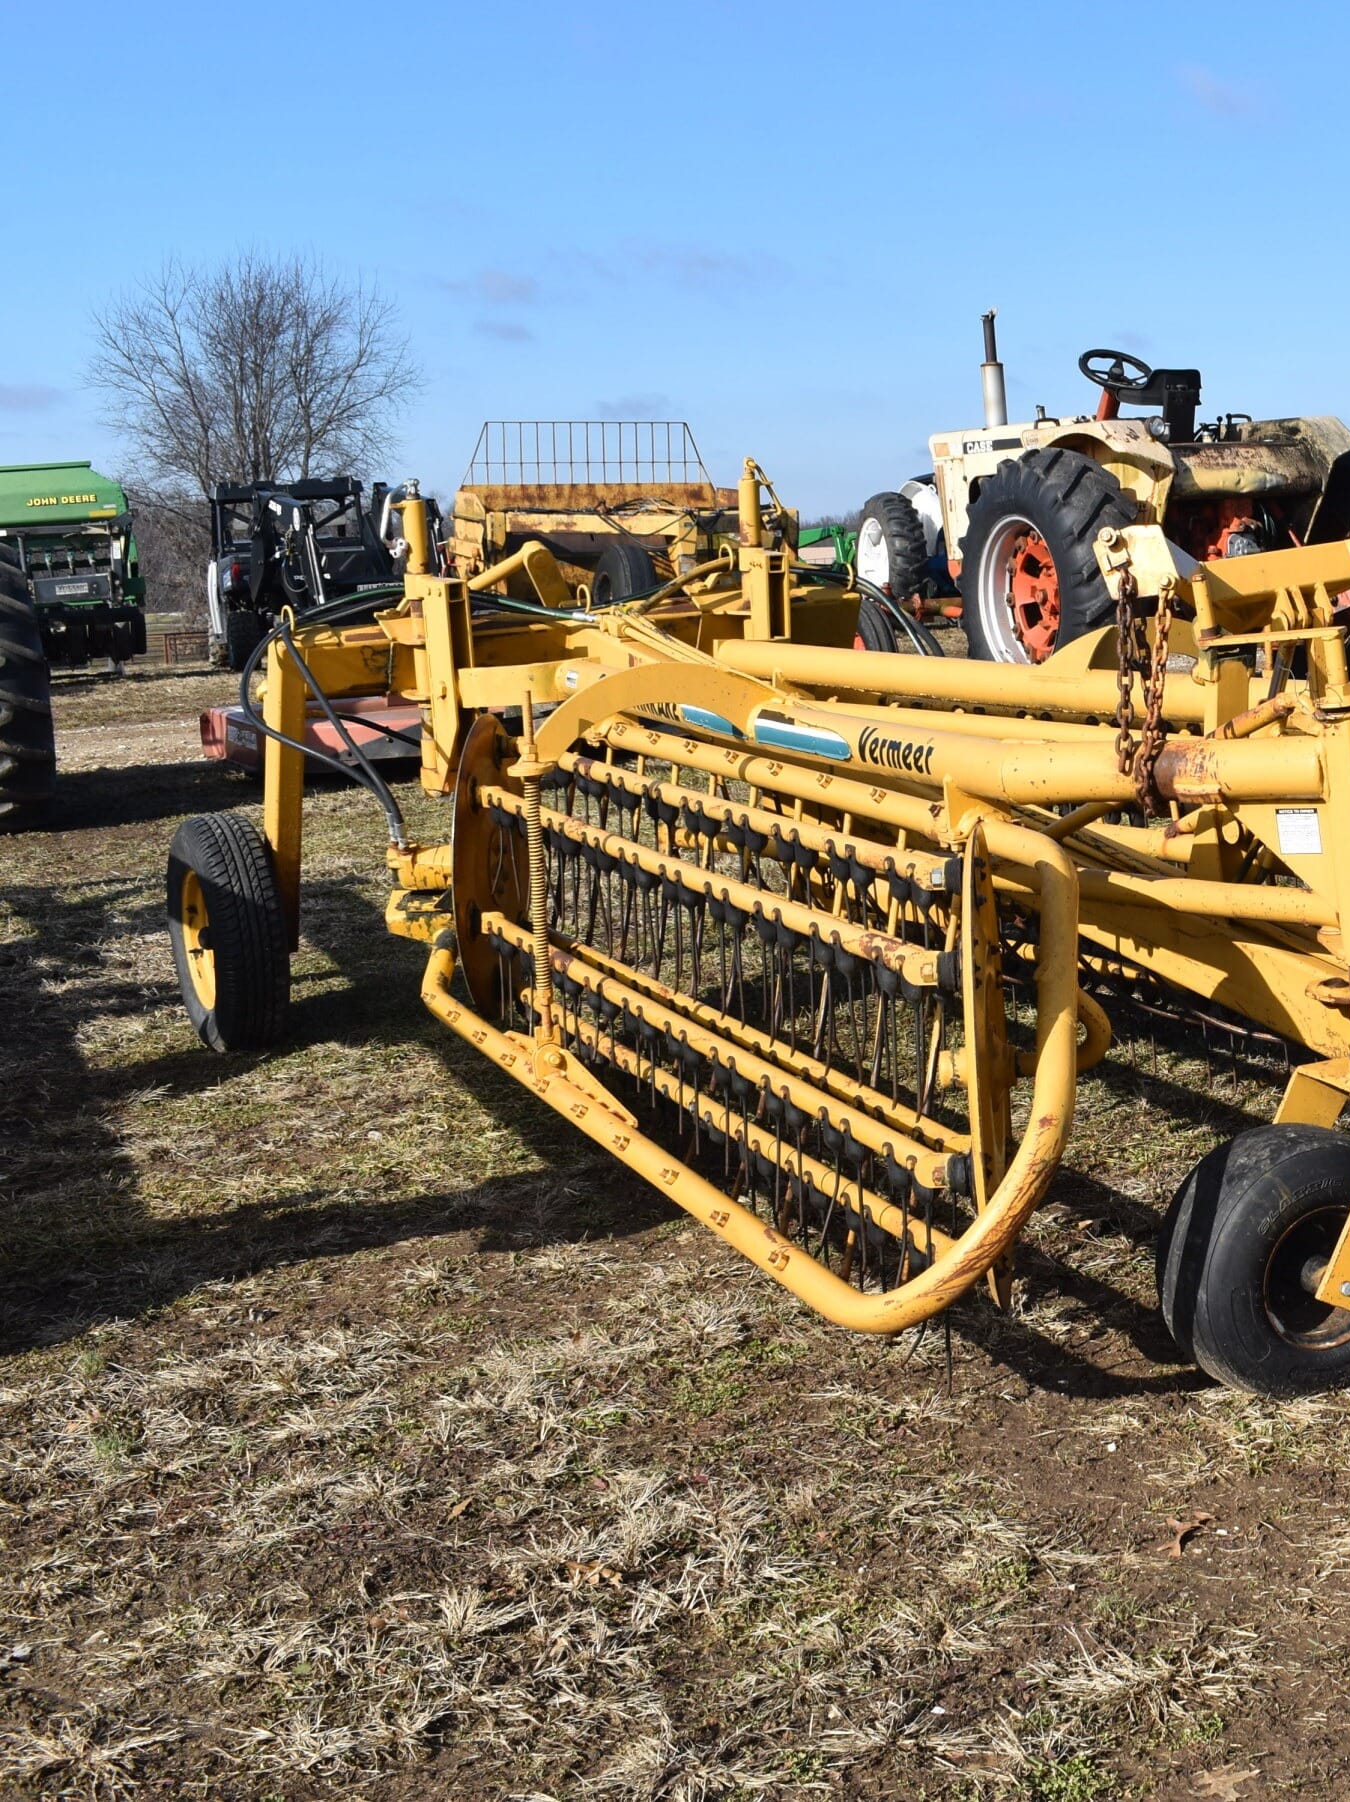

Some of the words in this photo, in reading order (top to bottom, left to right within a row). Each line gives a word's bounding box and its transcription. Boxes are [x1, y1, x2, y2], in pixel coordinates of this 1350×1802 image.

[966, 441, 993, 453] CASE
[26, 497, 58, 507] JOHN
[61, 494, 97, 504] DEERE
[858, 726, 935, 775] Vermeer
